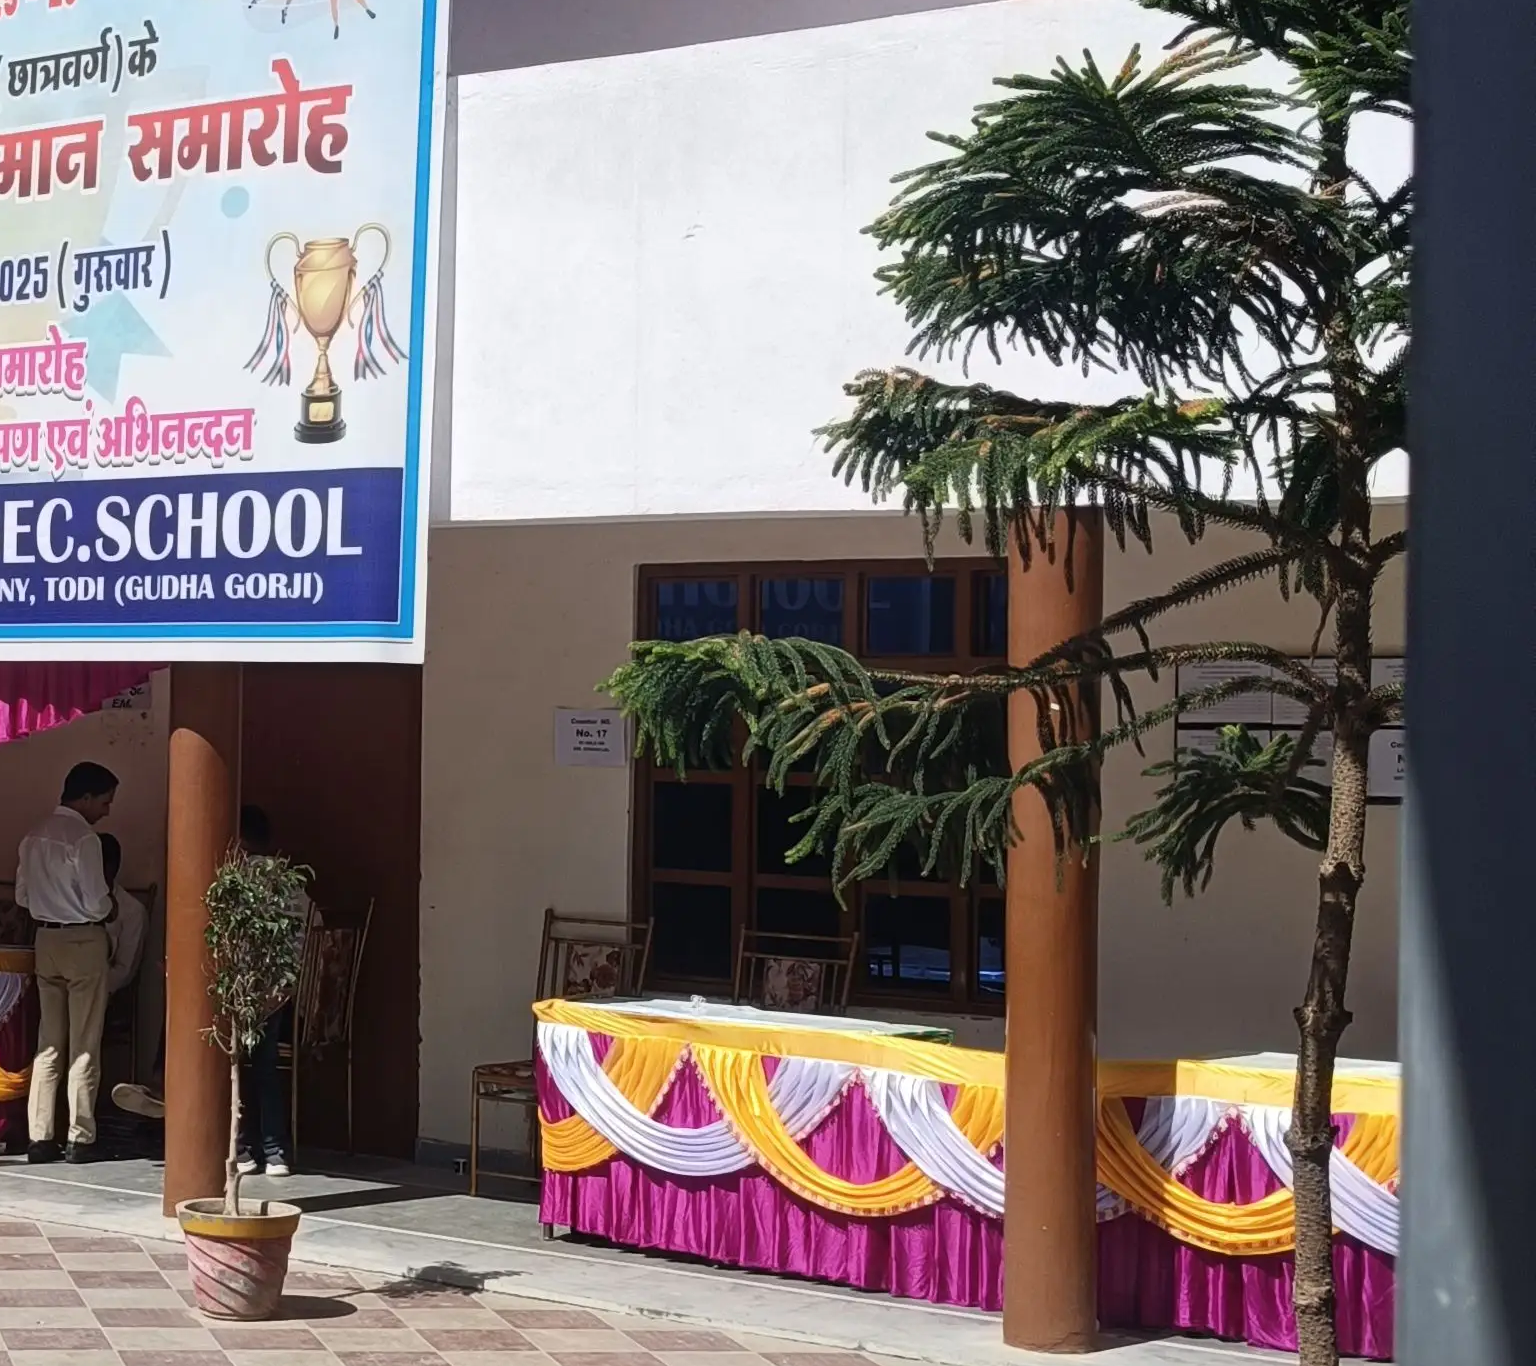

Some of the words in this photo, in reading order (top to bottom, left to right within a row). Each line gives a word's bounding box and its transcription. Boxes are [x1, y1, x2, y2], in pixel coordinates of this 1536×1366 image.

[128, 20, 160, 76] के
[128, 58, 353, 182] समारोह
[46, 399, 93, 471] एवं
[96, 395, 255, 458] अभिनन्दन
[44, 576, 105, 602] TODI
[114, 573, 215, 607] (GUDHA
[224, 572, 324, 605] GORJI)
[576, 728, 593, 738] No.
[596, 729, 608, 738] 17
